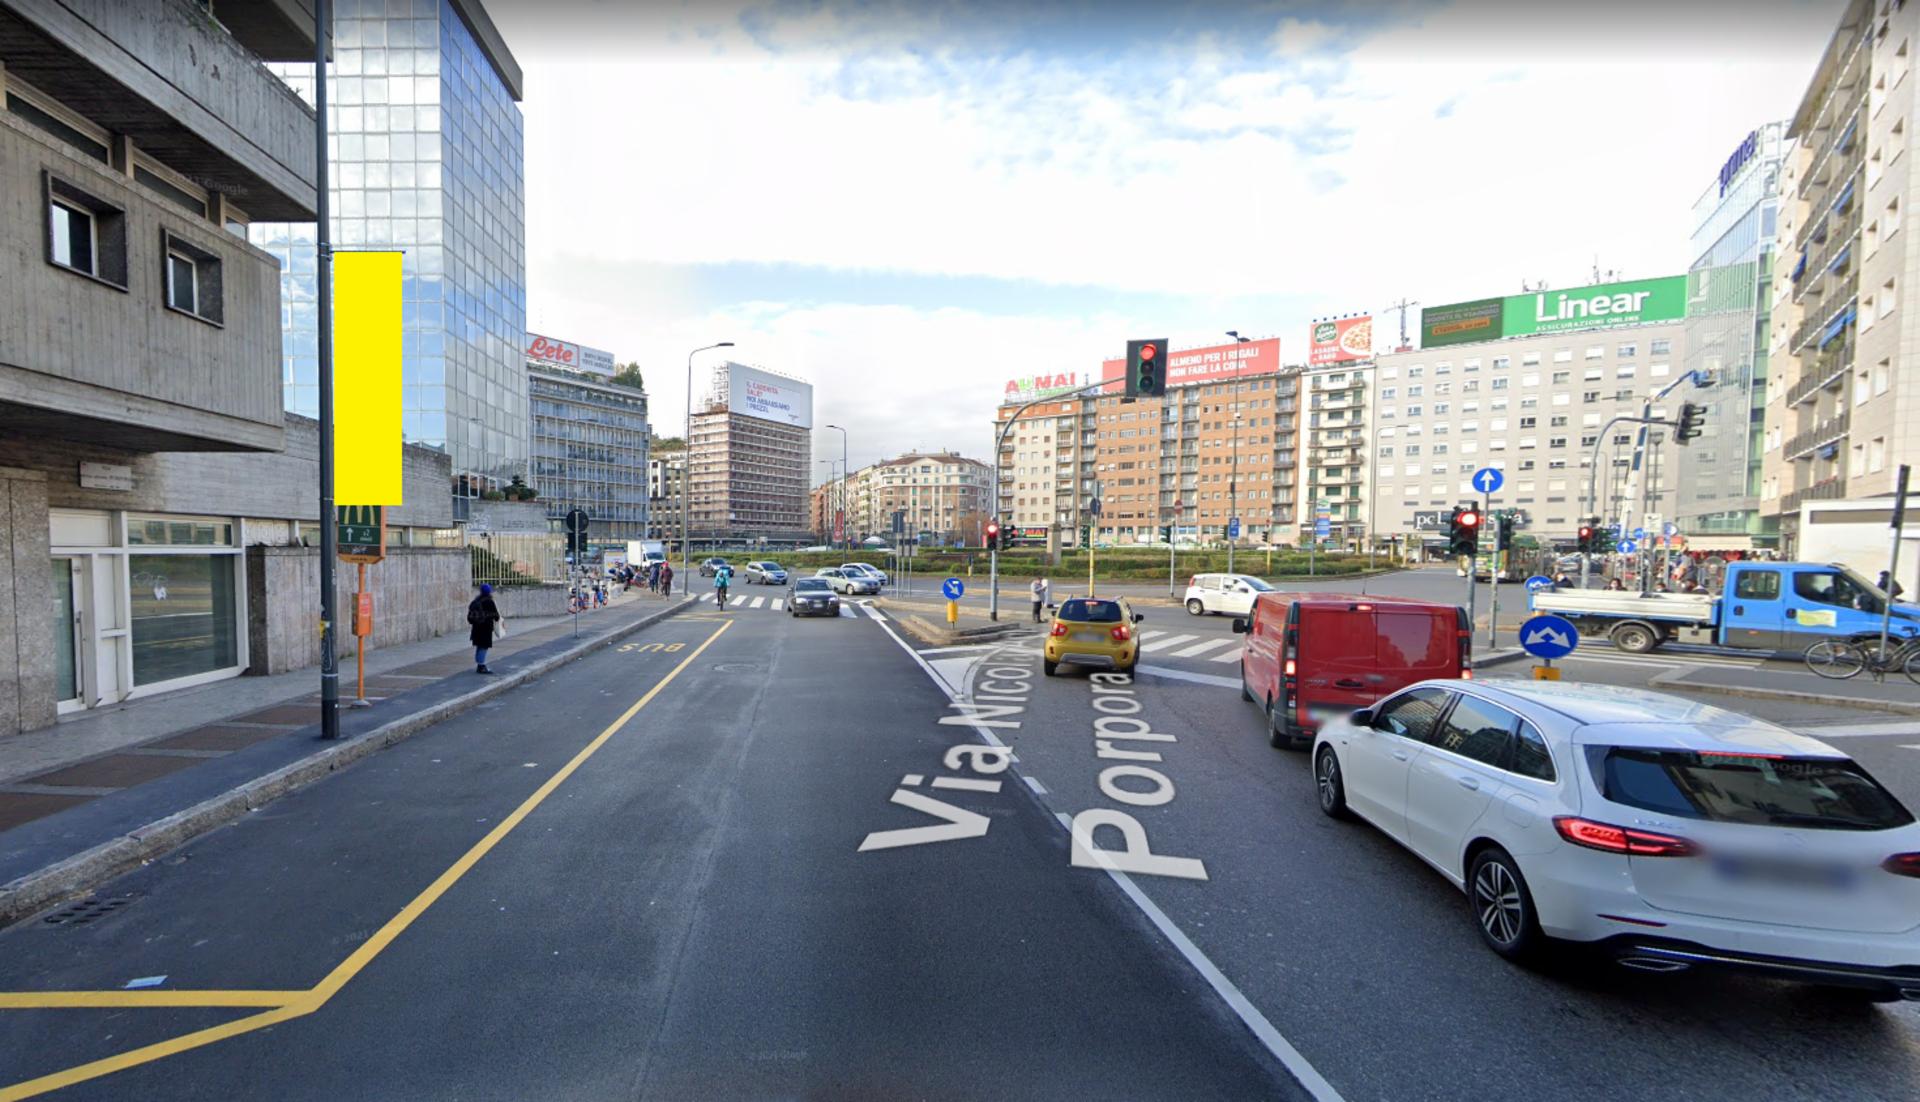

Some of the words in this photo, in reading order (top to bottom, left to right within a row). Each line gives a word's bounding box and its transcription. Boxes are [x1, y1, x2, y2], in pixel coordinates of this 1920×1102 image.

[1536, 291, 1650, 322] Linear
[527, 336, 574, 363] Lete
[1170, 355, 1202, 367] ALMENO
[1204, 352, 1221, 363] PER
[1169, 368, 1186, 377] NON
[1188, 365, 1208, 375] FARE
[1210, 363, 1221, 373] LA
[1005, 372, 1076, 394] AUMAI
[617, 643, 686, 653] BUS
